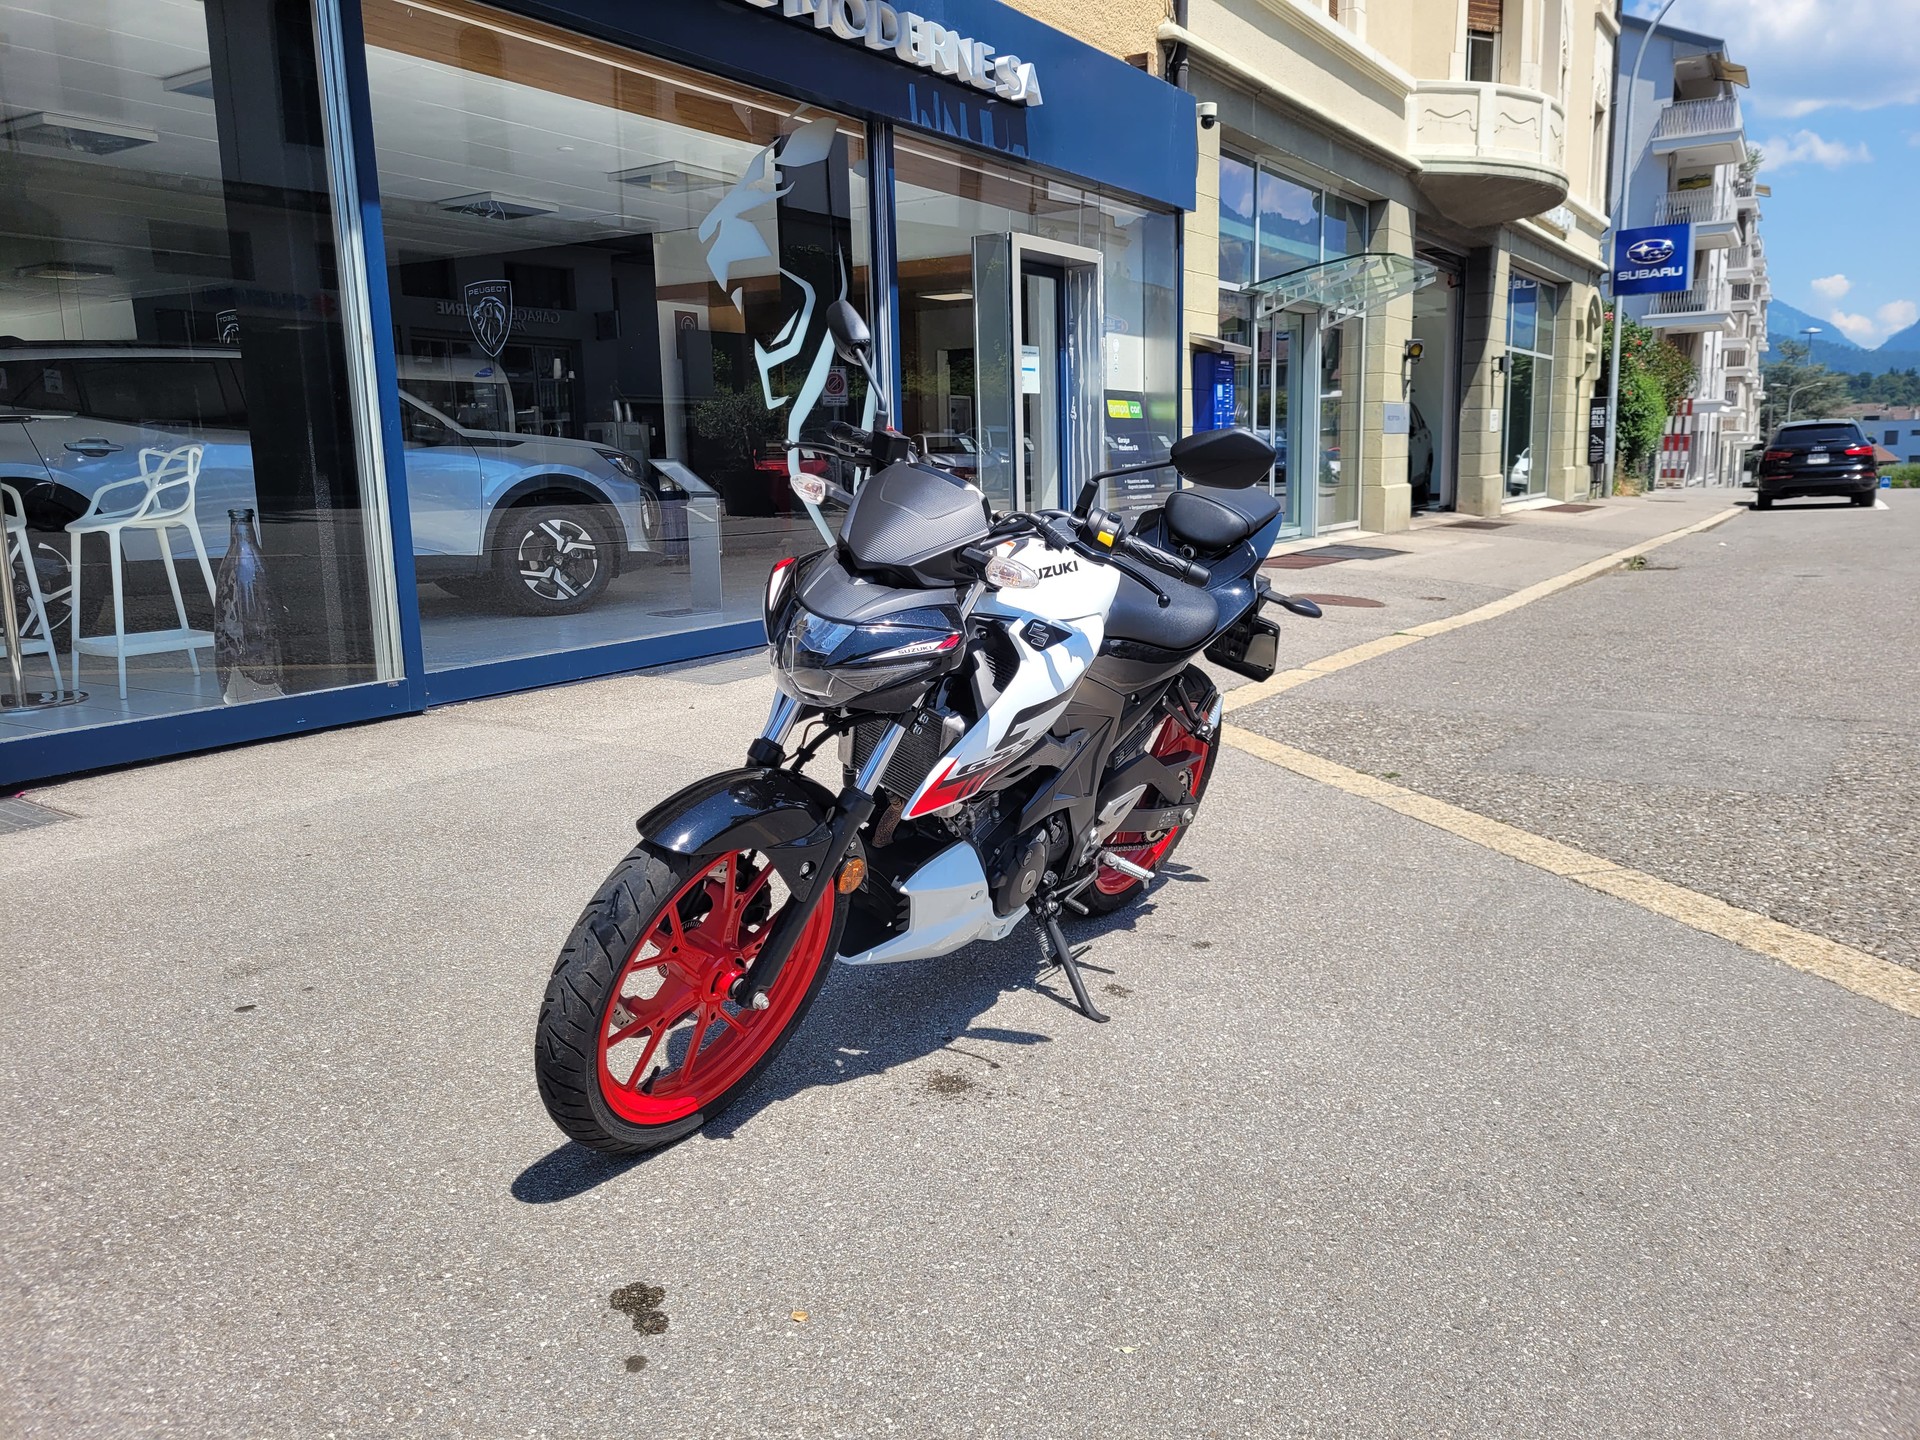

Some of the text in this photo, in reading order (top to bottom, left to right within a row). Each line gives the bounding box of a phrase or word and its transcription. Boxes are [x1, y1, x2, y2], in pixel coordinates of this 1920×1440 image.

[995, 55, 1043, 107] SA
[1617, 266, 1683, 281] SUBARU
[468, 285, 507, 297] PEUGEOT
[1033, 560, 1079, 580] UZUKI
[898, 645, 932, 654] SUZUKI
